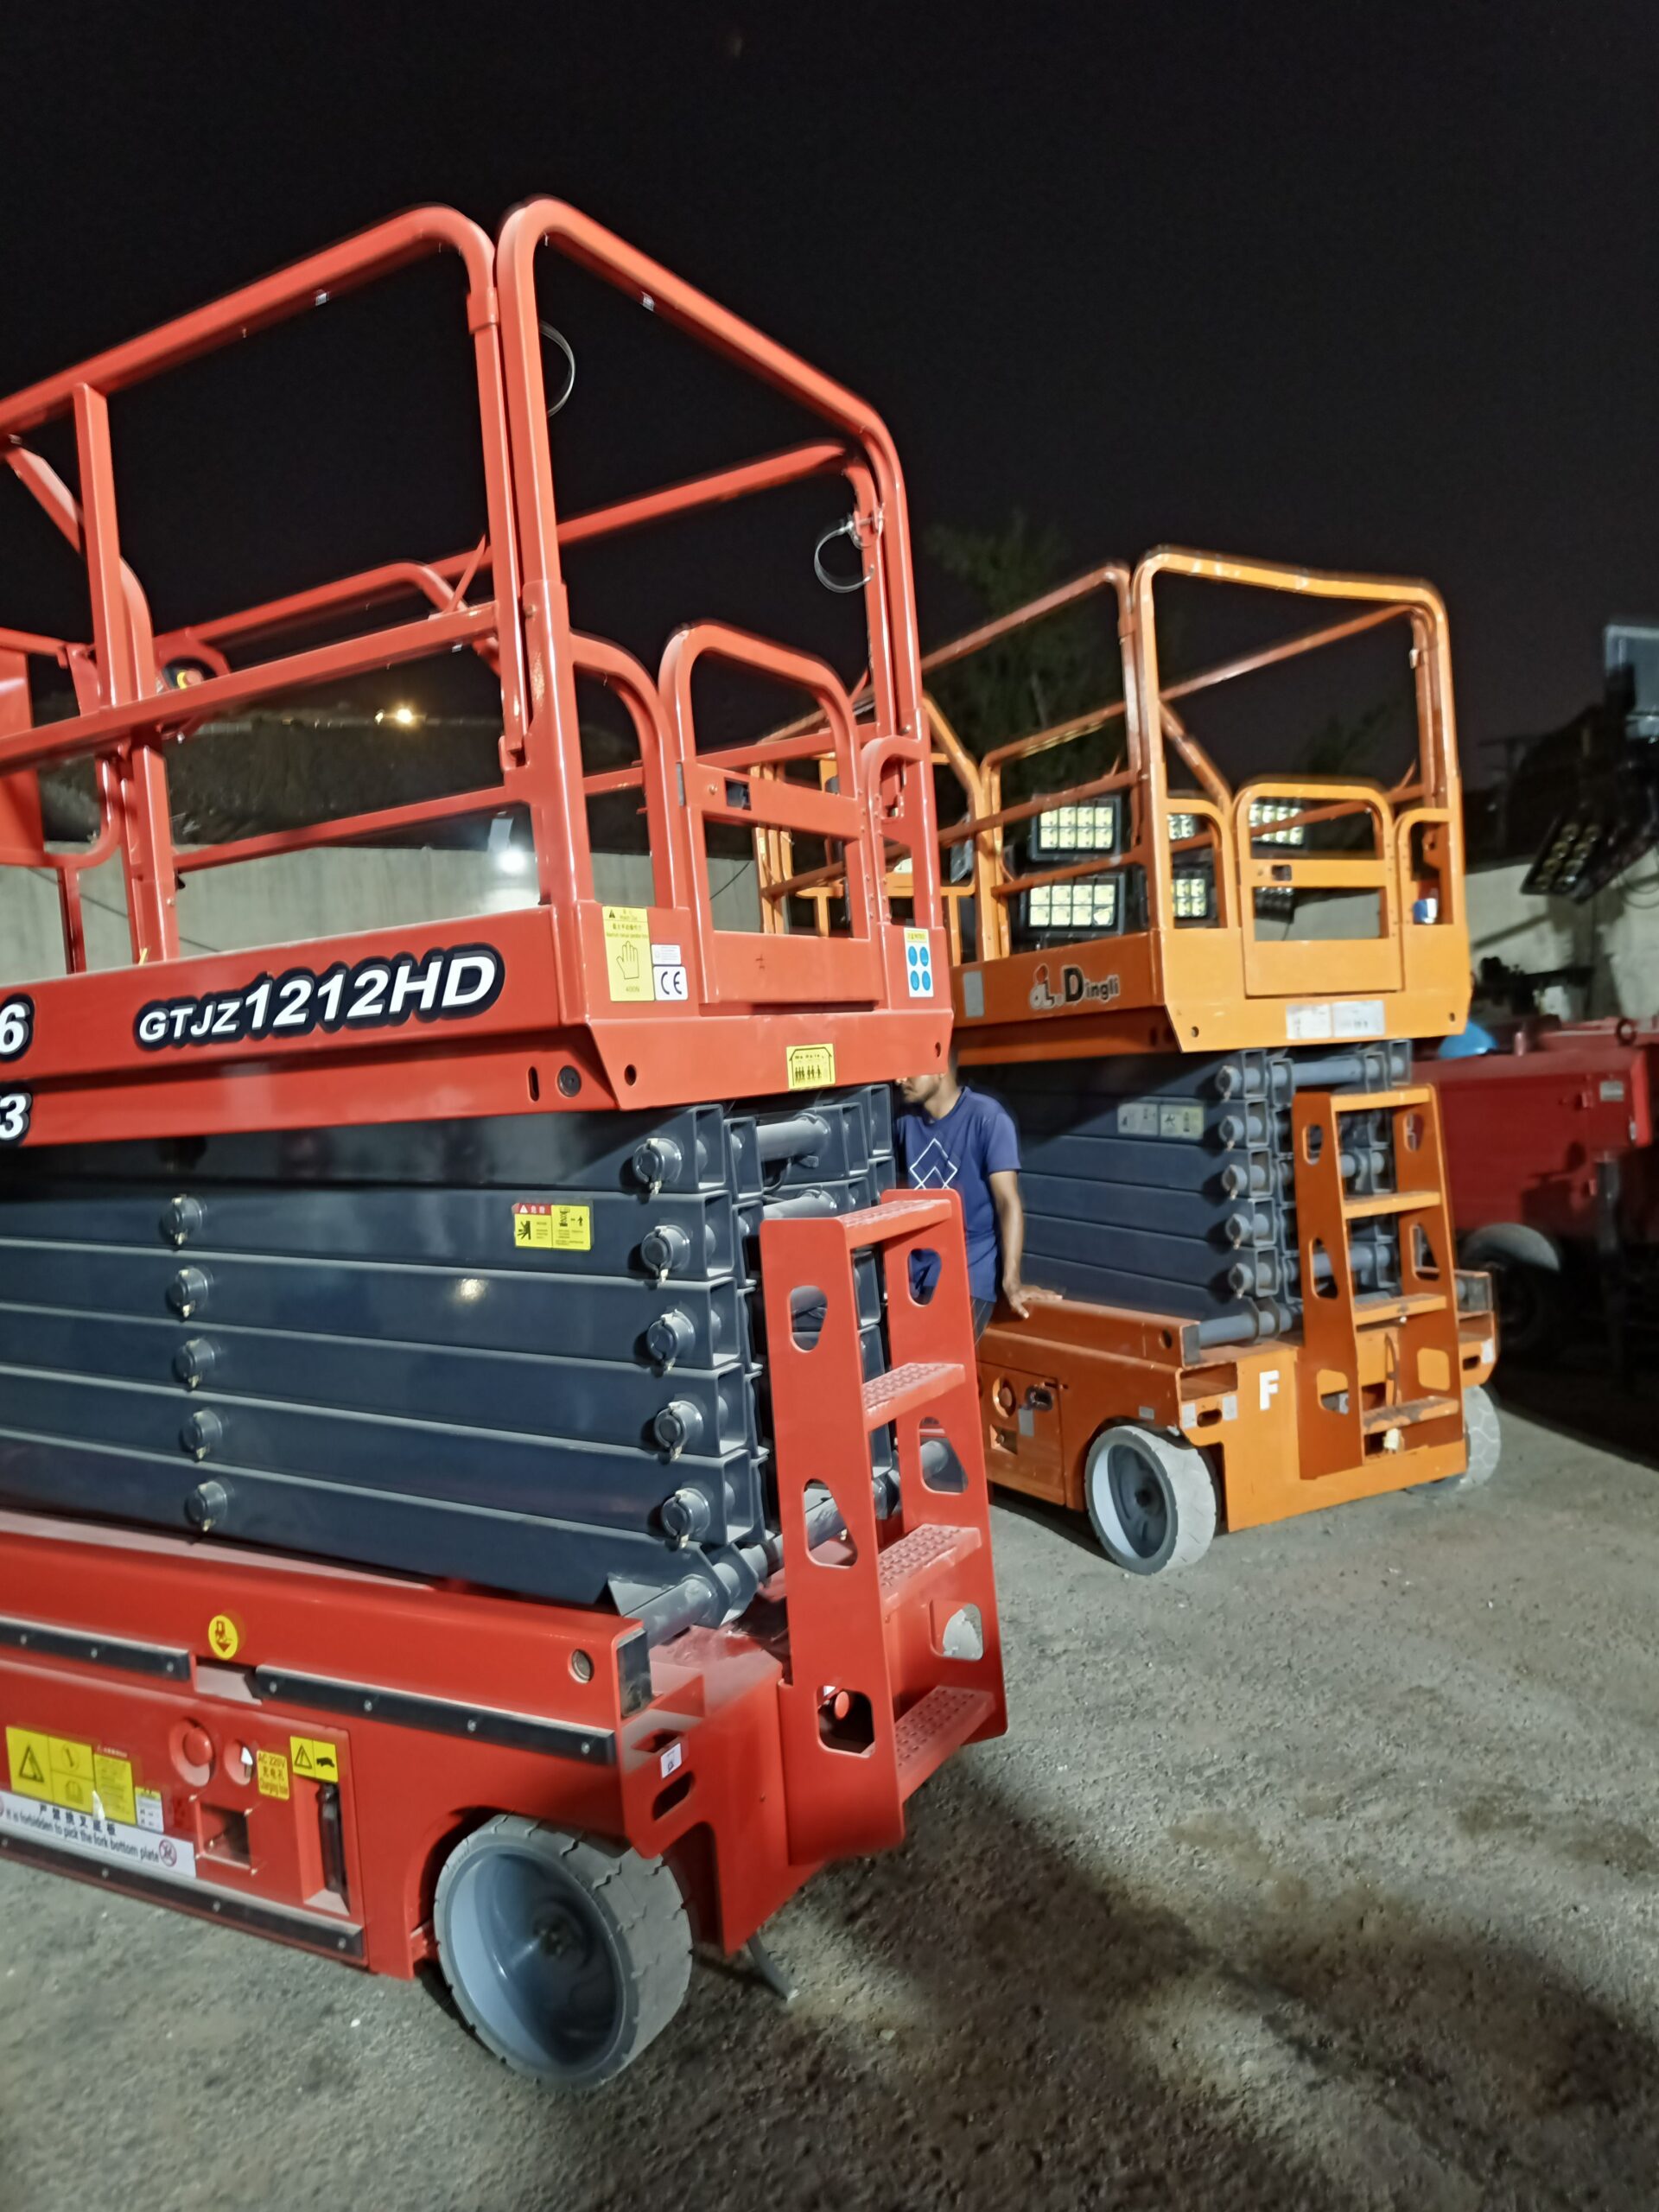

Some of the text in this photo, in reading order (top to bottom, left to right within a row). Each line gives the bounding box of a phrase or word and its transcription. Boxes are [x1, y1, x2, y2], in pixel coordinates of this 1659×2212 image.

[139, 955, 497, 1043] GTJZ1212HD
[661, 970, 683, 995] CE
[1063, 967, 1119, 1002] Dingli
[1259, 1370, 1280, 1411] F
[54, 1822, 63, 1835] to
[64, 1823, 79, 1840] pick
[80, 1827, 93, 1843] the
[110, 1836, 139, 1857] bottom
[140, 1843, 160, 1863] plate
